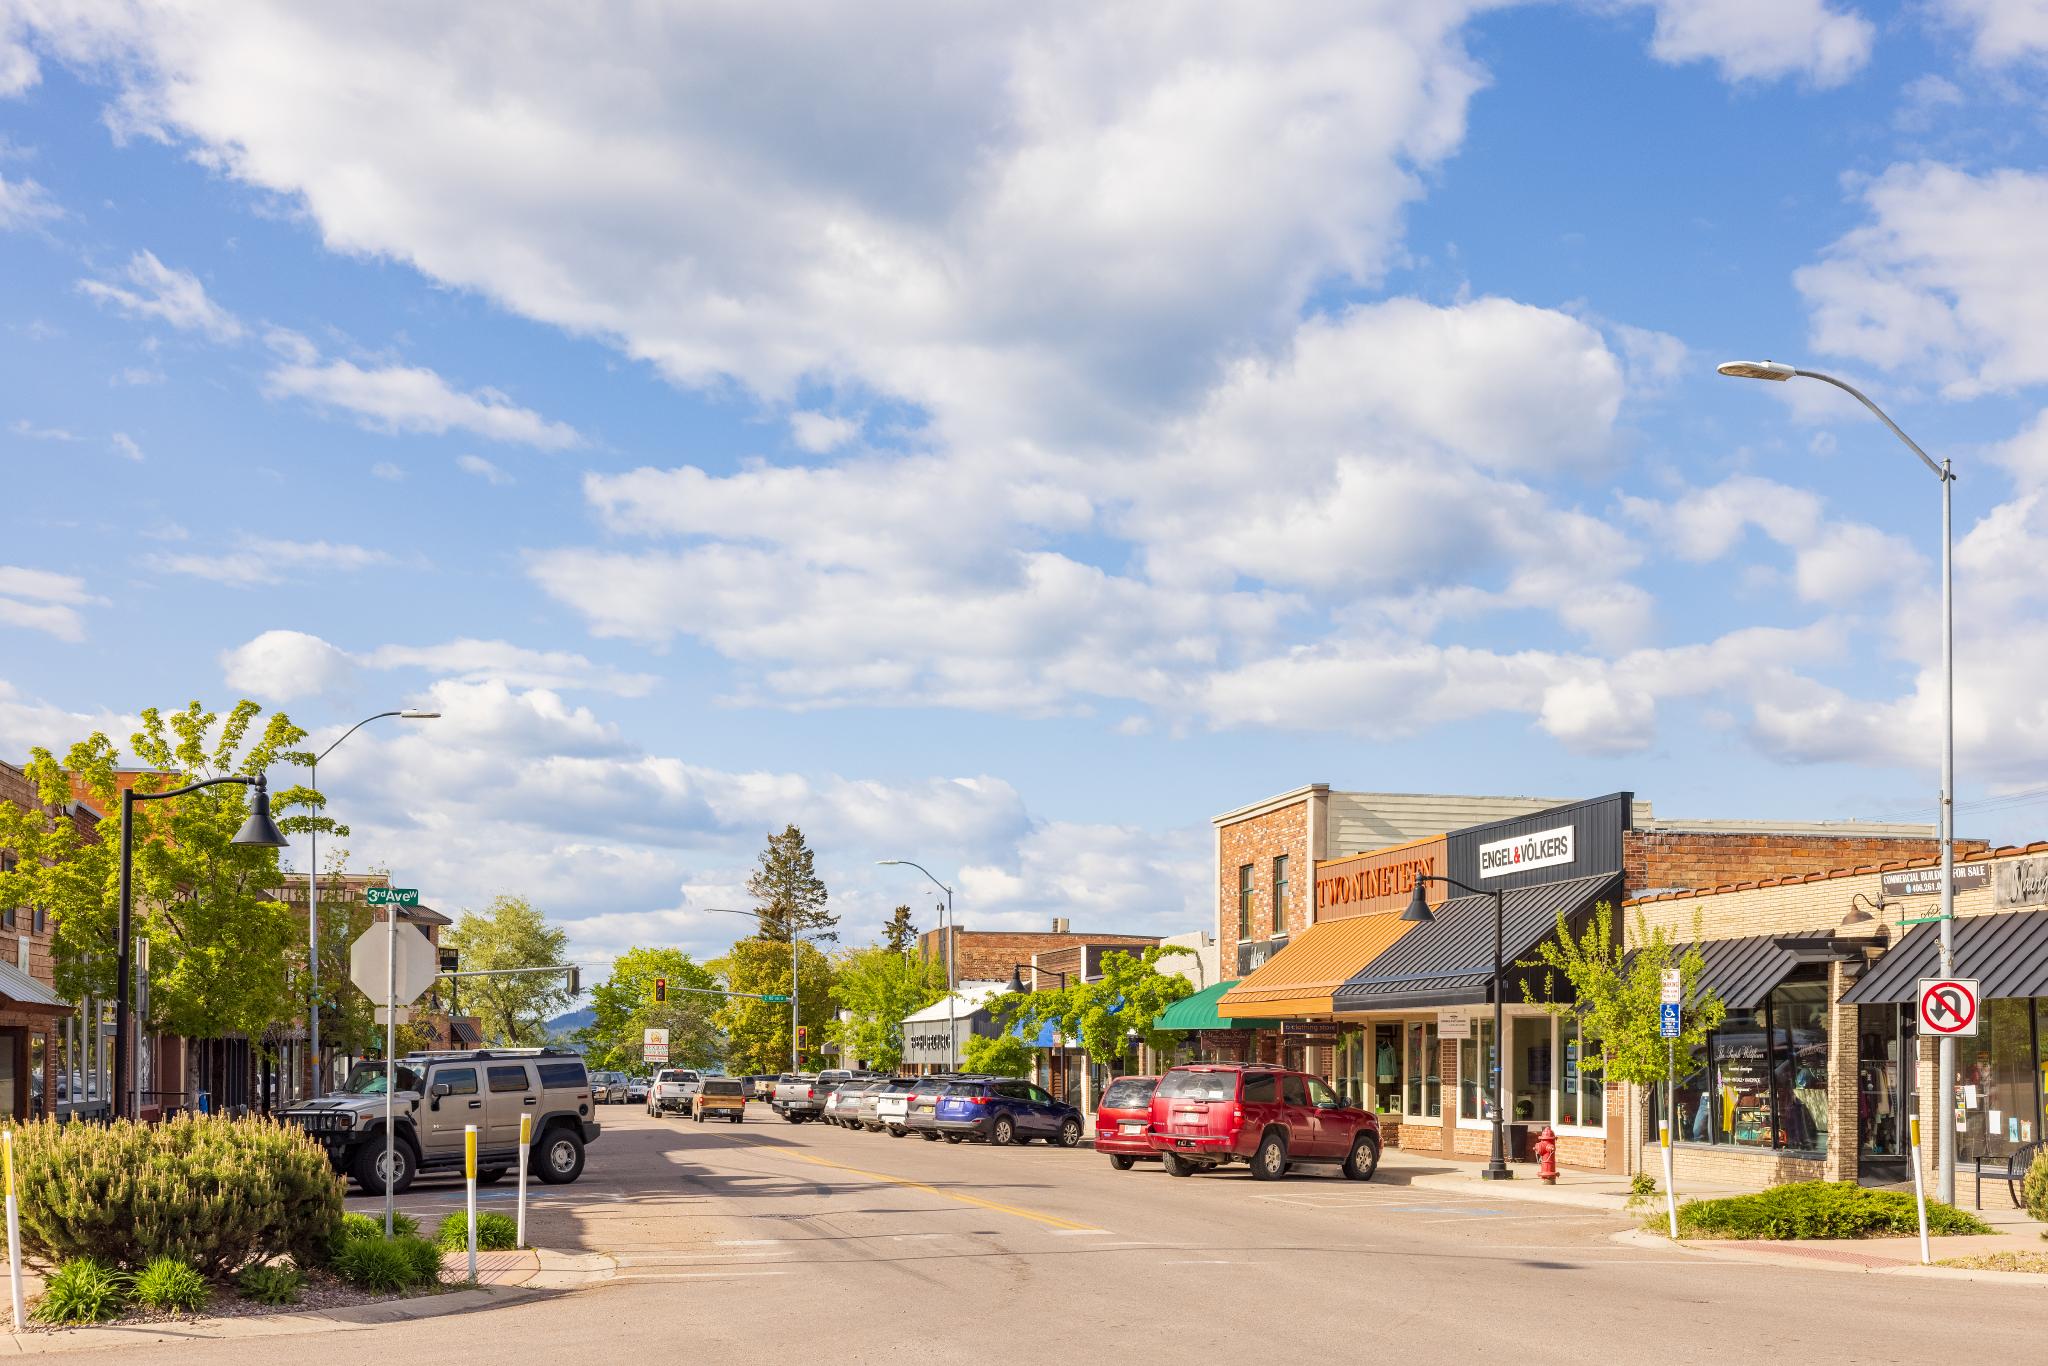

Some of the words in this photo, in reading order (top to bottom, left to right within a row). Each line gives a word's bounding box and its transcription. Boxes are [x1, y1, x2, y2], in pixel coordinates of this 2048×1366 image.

[1317, 876, 1350, 908] TWO
[1351, 857, 1434, 901] NINETEEN
[1883, 872, 1920, 885] COMMERCIAL
[1920, 870, 1941, 881] BUILDI
[1952, 867, 1966, 878] FOR
[1967, 865, 1986, 877] SALE
[368, 889, 386, 902] 3rd
[386, 890, 410, 902] Ave
